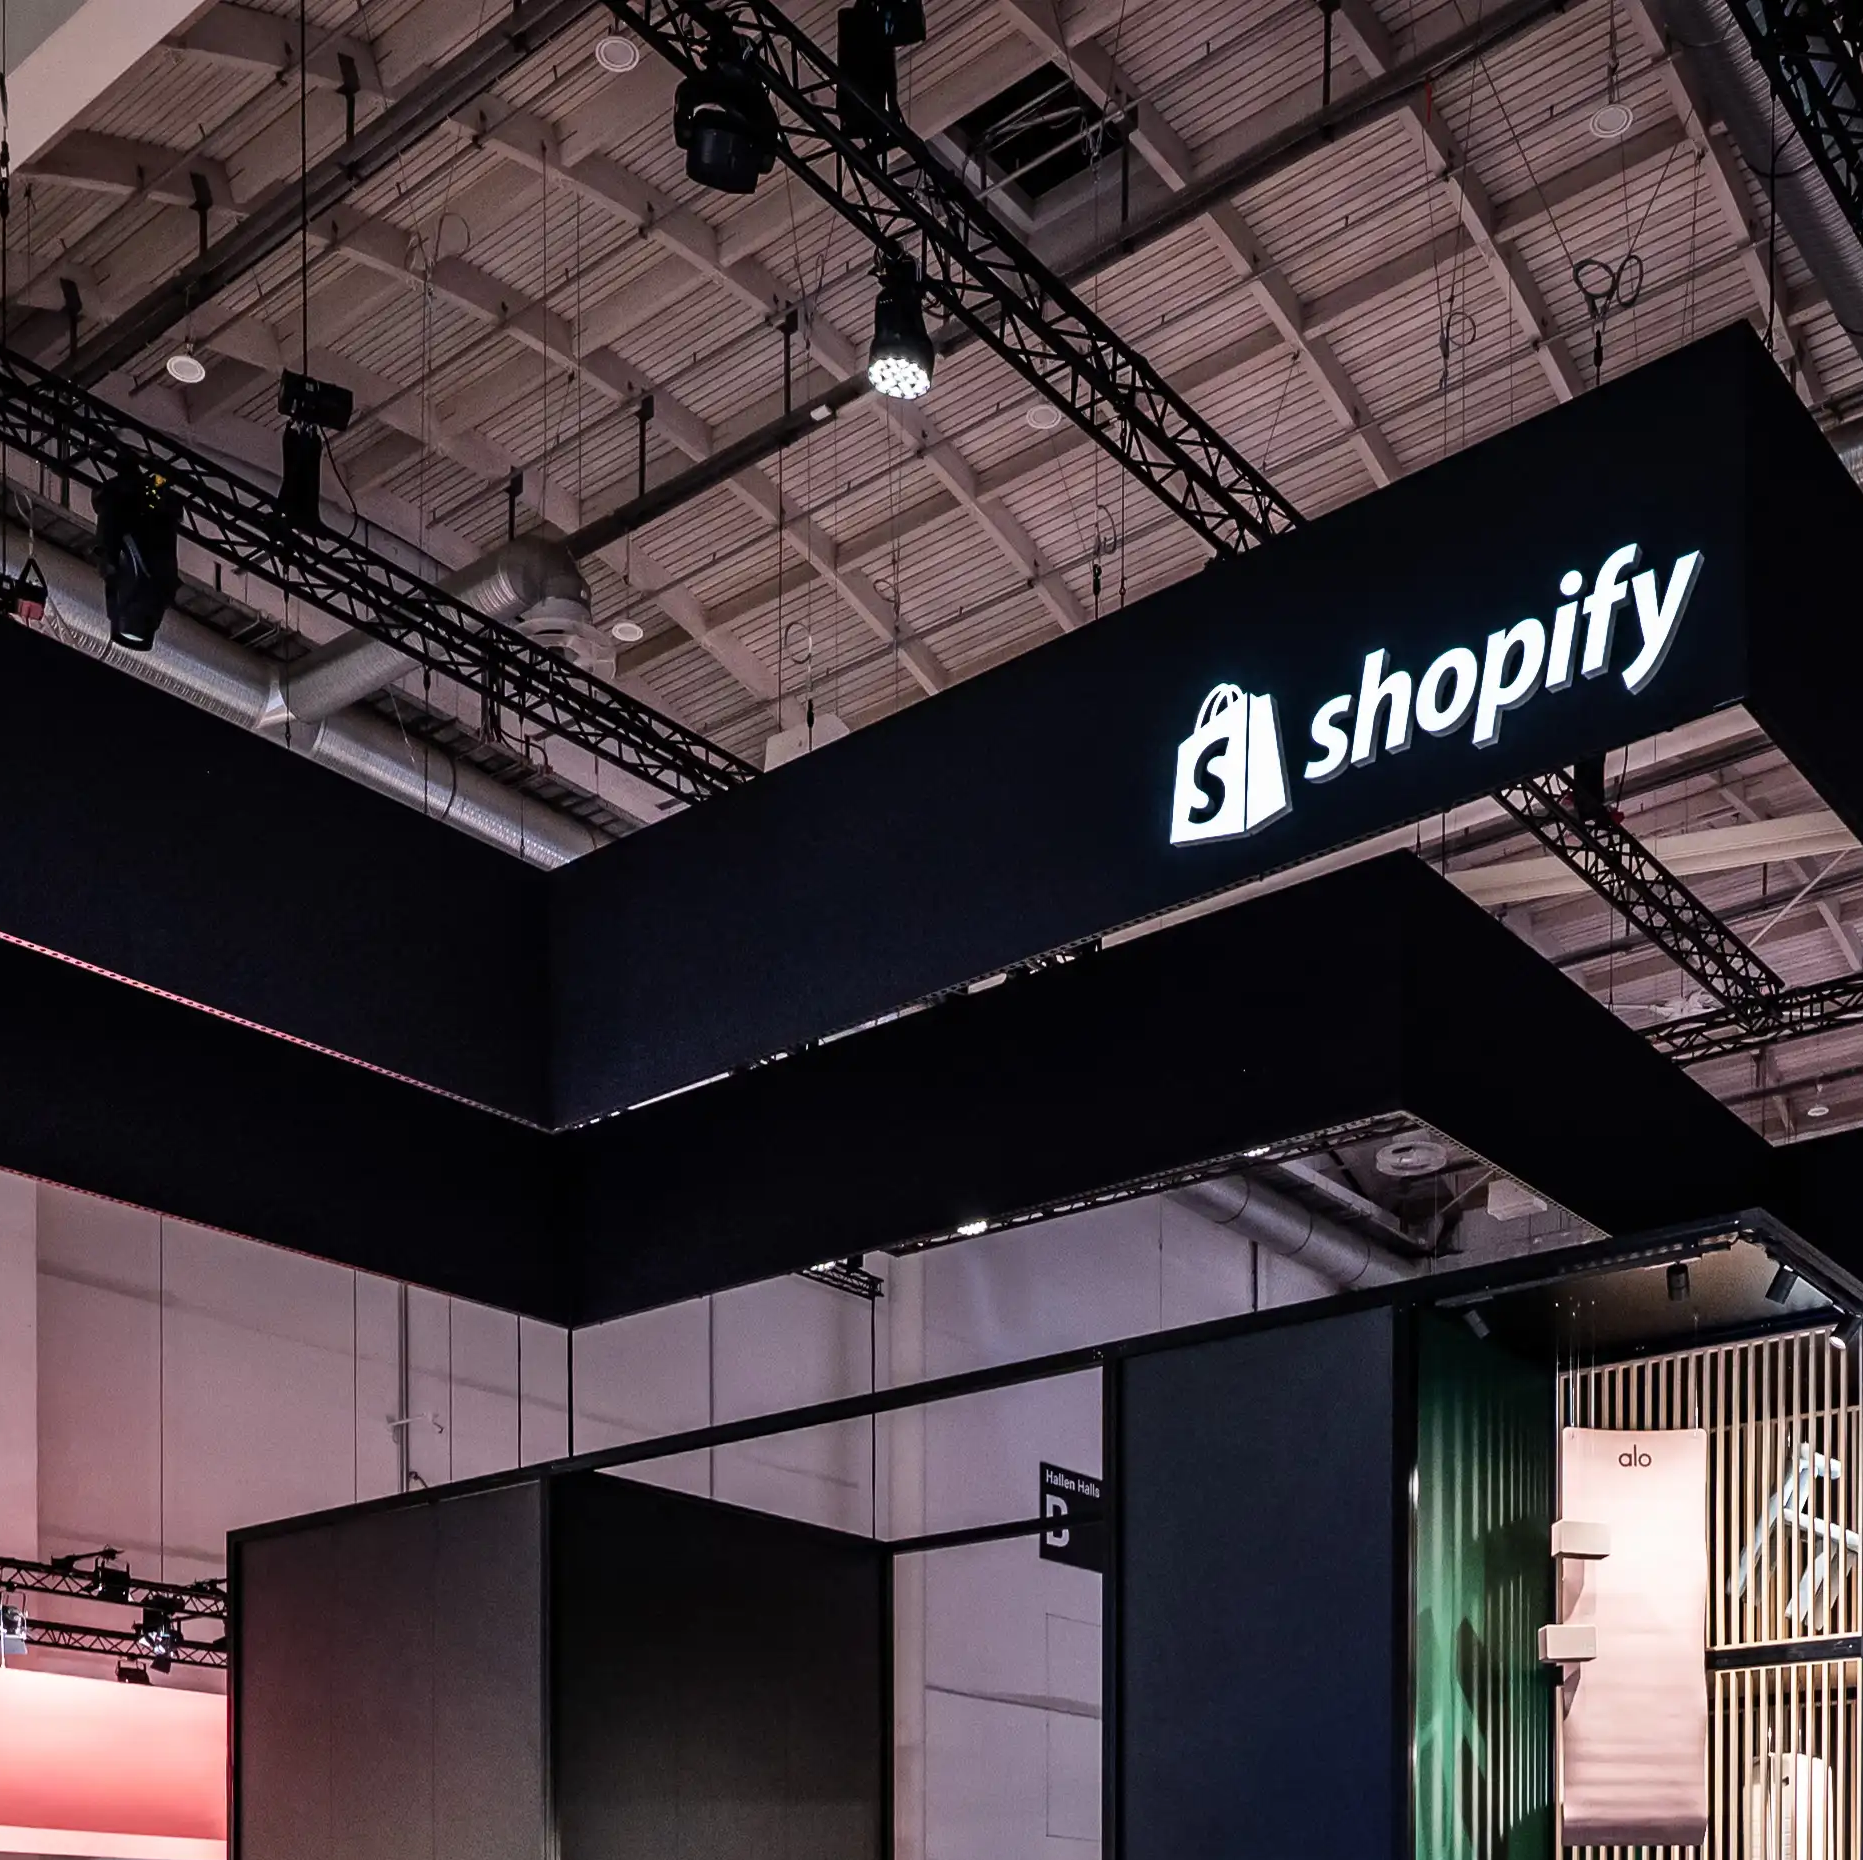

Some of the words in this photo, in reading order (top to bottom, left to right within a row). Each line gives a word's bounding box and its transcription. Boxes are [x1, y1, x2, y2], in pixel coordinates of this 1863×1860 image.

[1303, 542, 1705, 783] shopify
[1618, 1444, 1652, 1467] alo
[1045, 1469, 1076, 1491] Hallen
[1077, 1479, 1100, 1498] Halls
